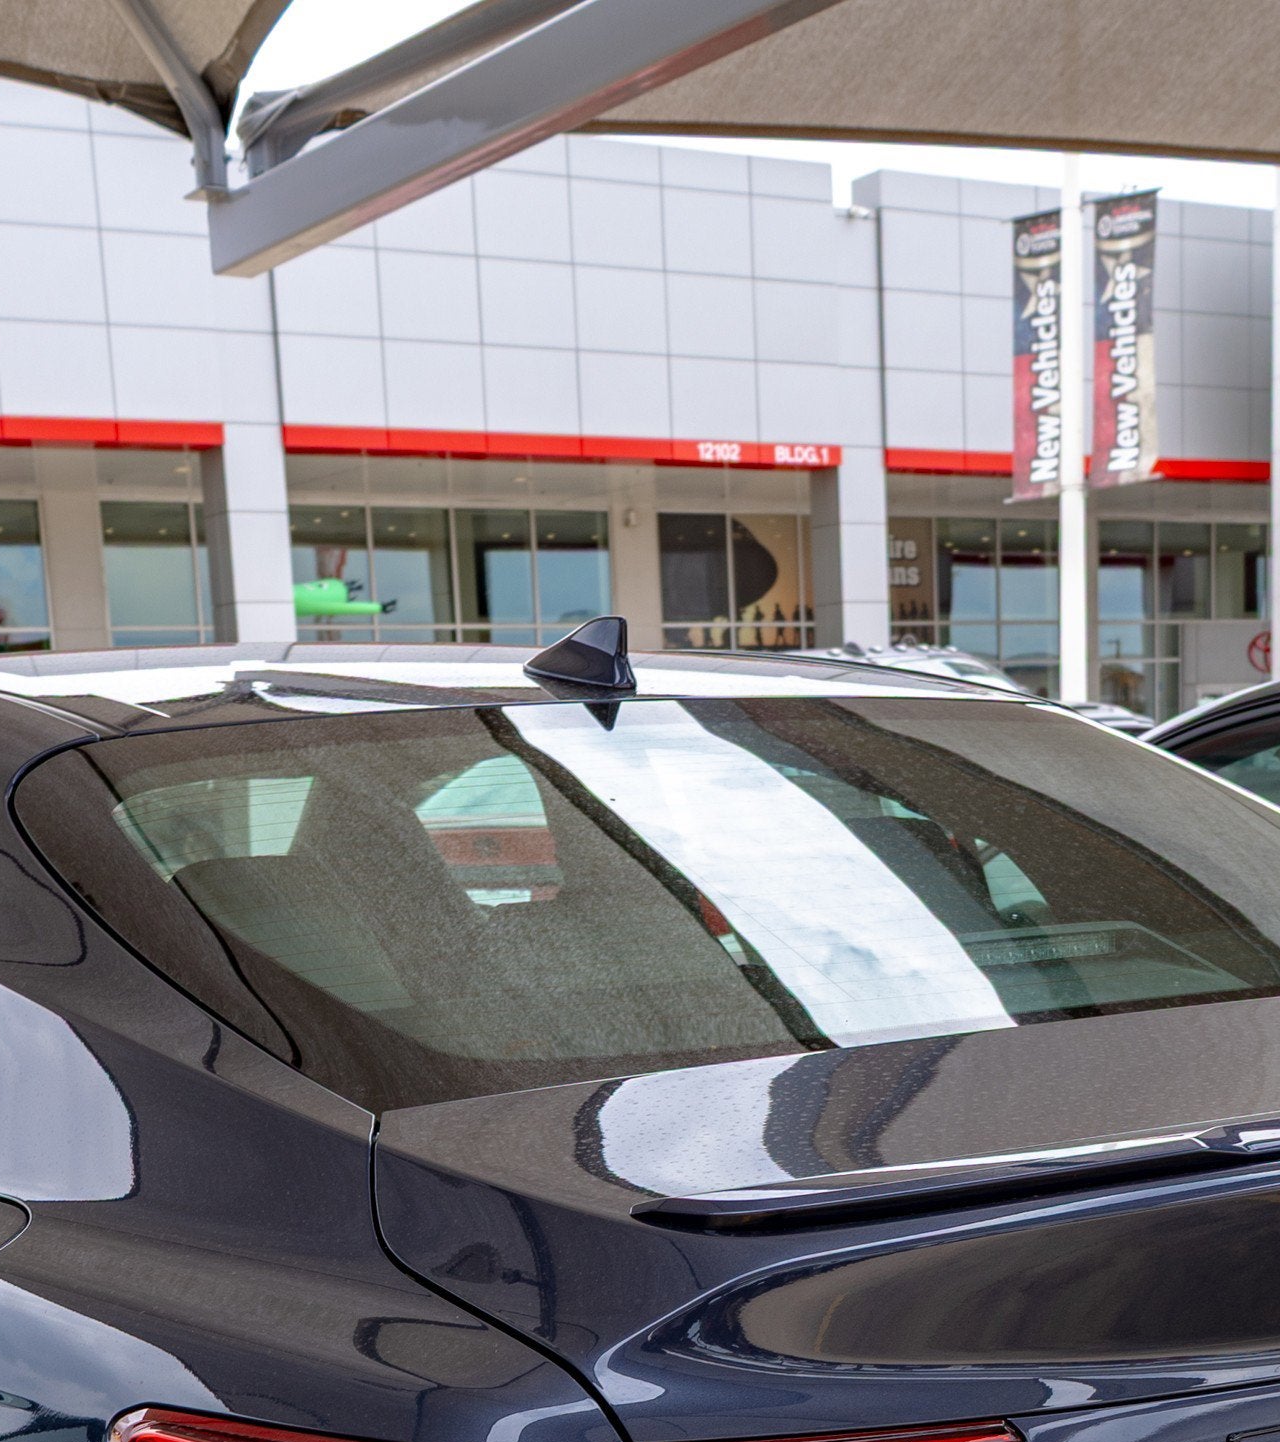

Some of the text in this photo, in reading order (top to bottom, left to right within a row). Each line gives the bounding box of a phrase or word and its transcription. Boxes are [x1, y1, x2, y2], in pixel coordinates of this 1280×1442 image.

[1031, 279, 1060, 412] Vehicles
[1108, 262, 1138, 399] Vehicles
[697, 443, 741, 462] 12102
[1030, 415, 1061, 483] New
[1108, 401, 1140, 472] New
